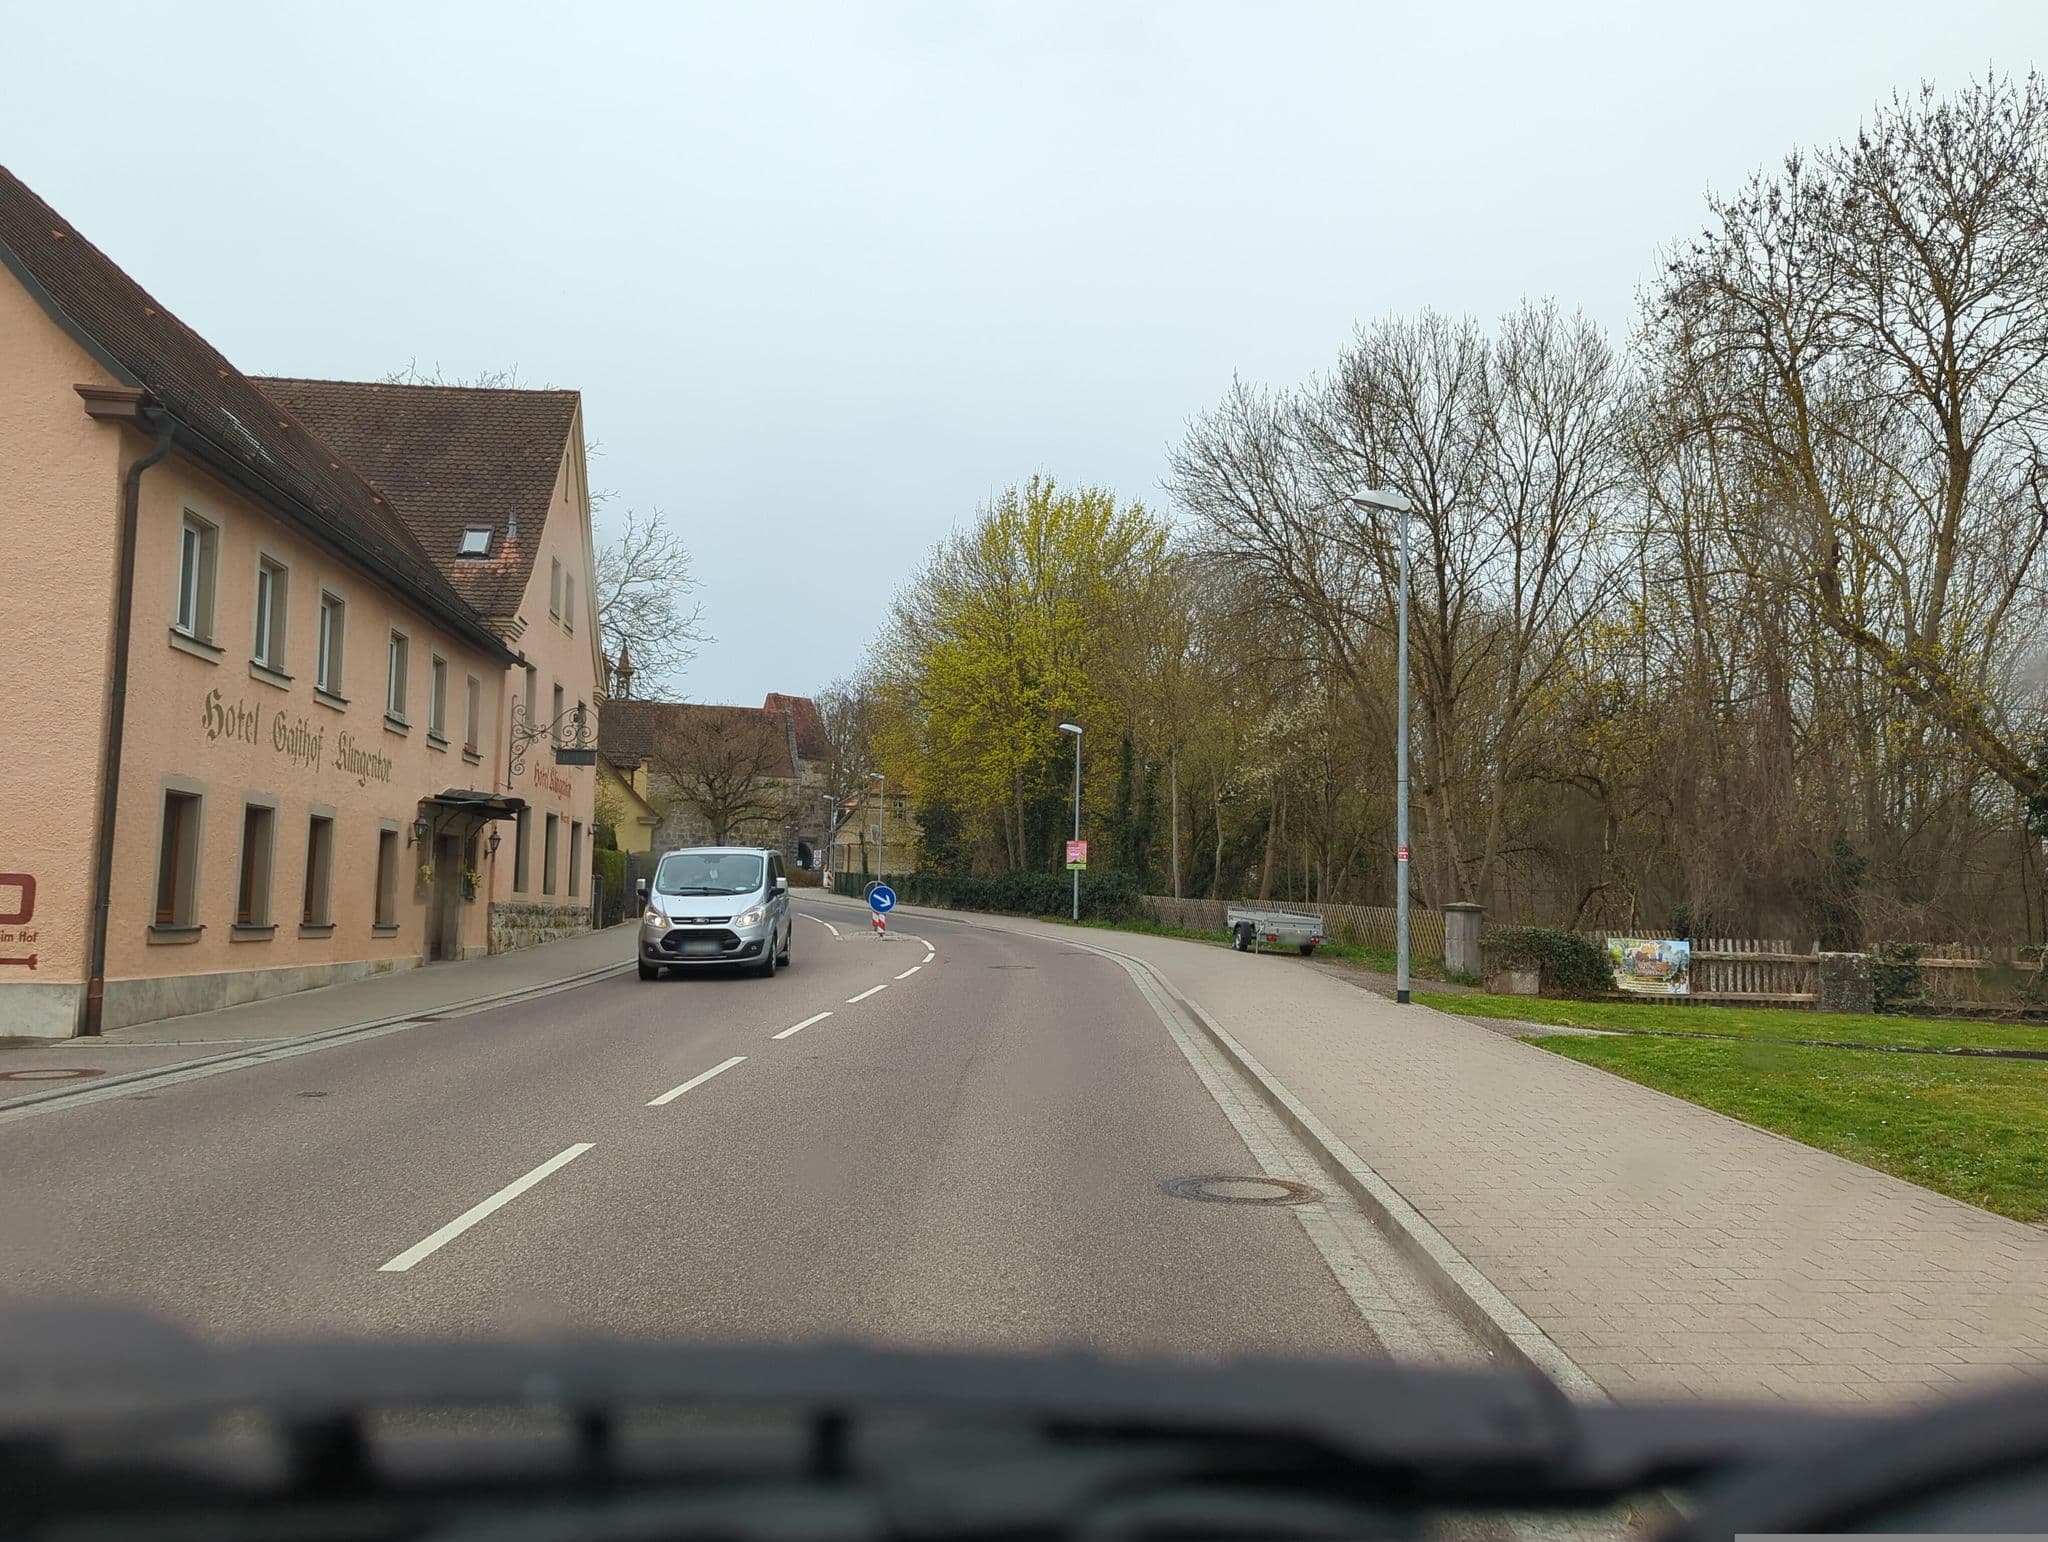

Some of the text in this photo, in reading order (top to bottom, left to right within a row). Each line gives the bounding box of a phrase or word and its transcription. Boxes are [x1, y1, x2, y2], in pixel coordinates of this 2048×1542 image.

[202, 688, 393, 788] Hotel Gasthof Klingentor
[0, 930, 39, 943] im Hof
